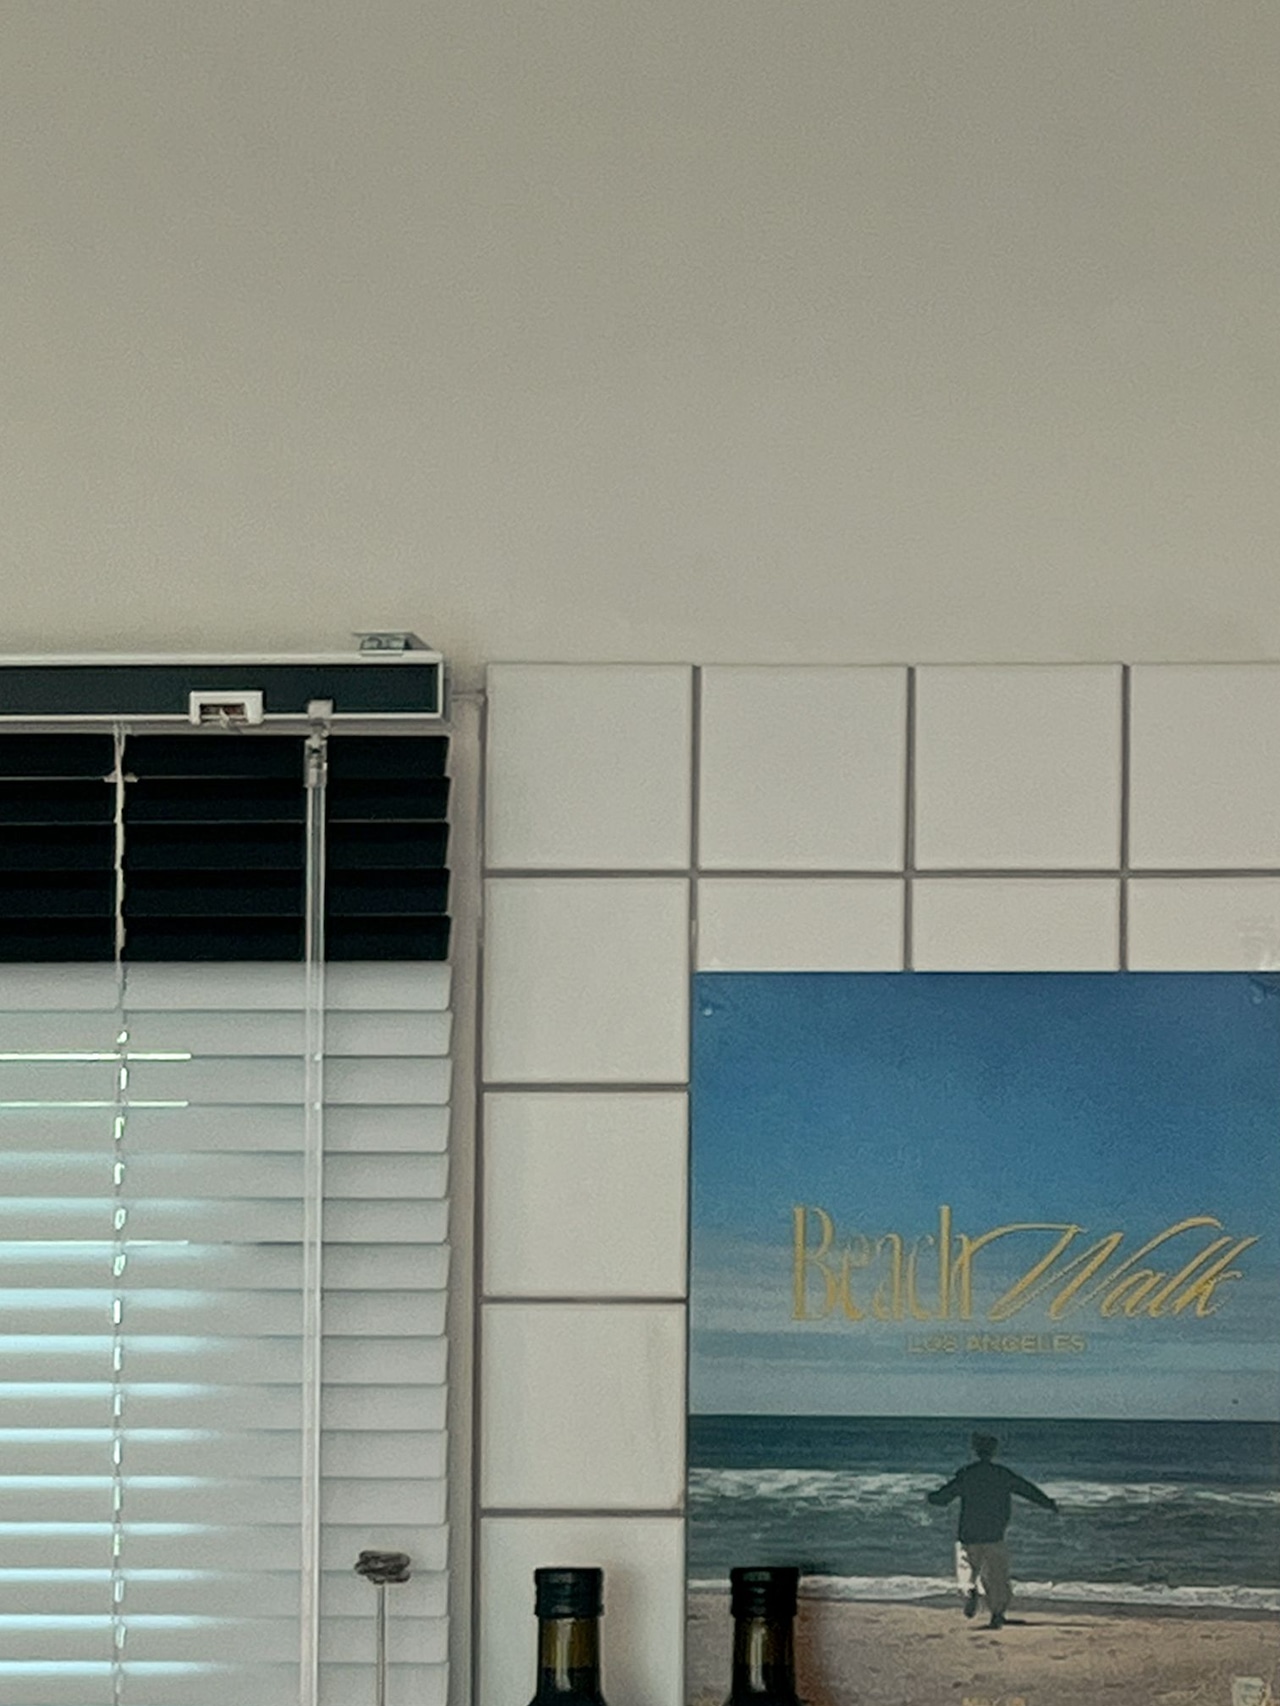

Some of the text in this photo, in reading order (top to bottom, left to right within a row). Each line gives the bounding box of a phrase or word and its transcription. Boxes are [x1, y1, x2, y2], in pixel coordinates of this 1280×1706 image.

[791, 1205, 1261, 1321] Beach Walk
[907, 1333, 1086, 1353] LOS ANGELES
